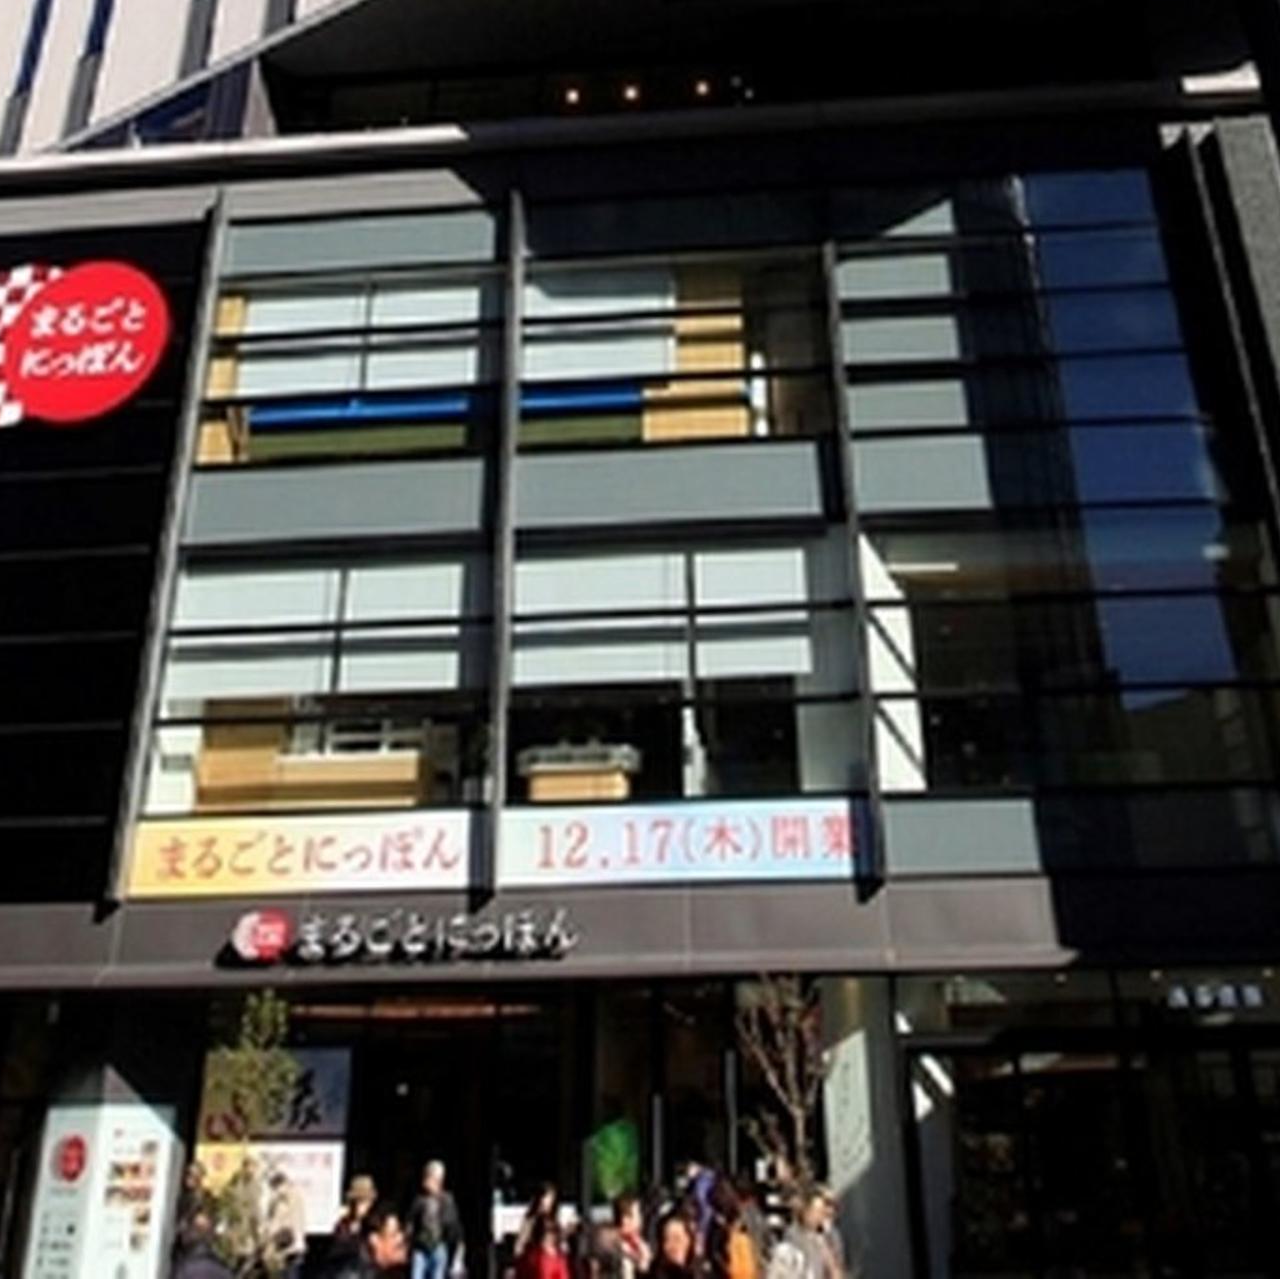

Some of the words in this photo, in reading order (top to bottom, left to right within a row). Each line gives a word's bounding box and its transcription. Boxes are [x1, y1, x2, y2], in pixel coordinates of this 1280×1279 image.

[30, 296, 147, 339] まるごと
[19, 339, 144, 379] にっぽん
[156, 827, 460, 881] まるごとにっぽん
